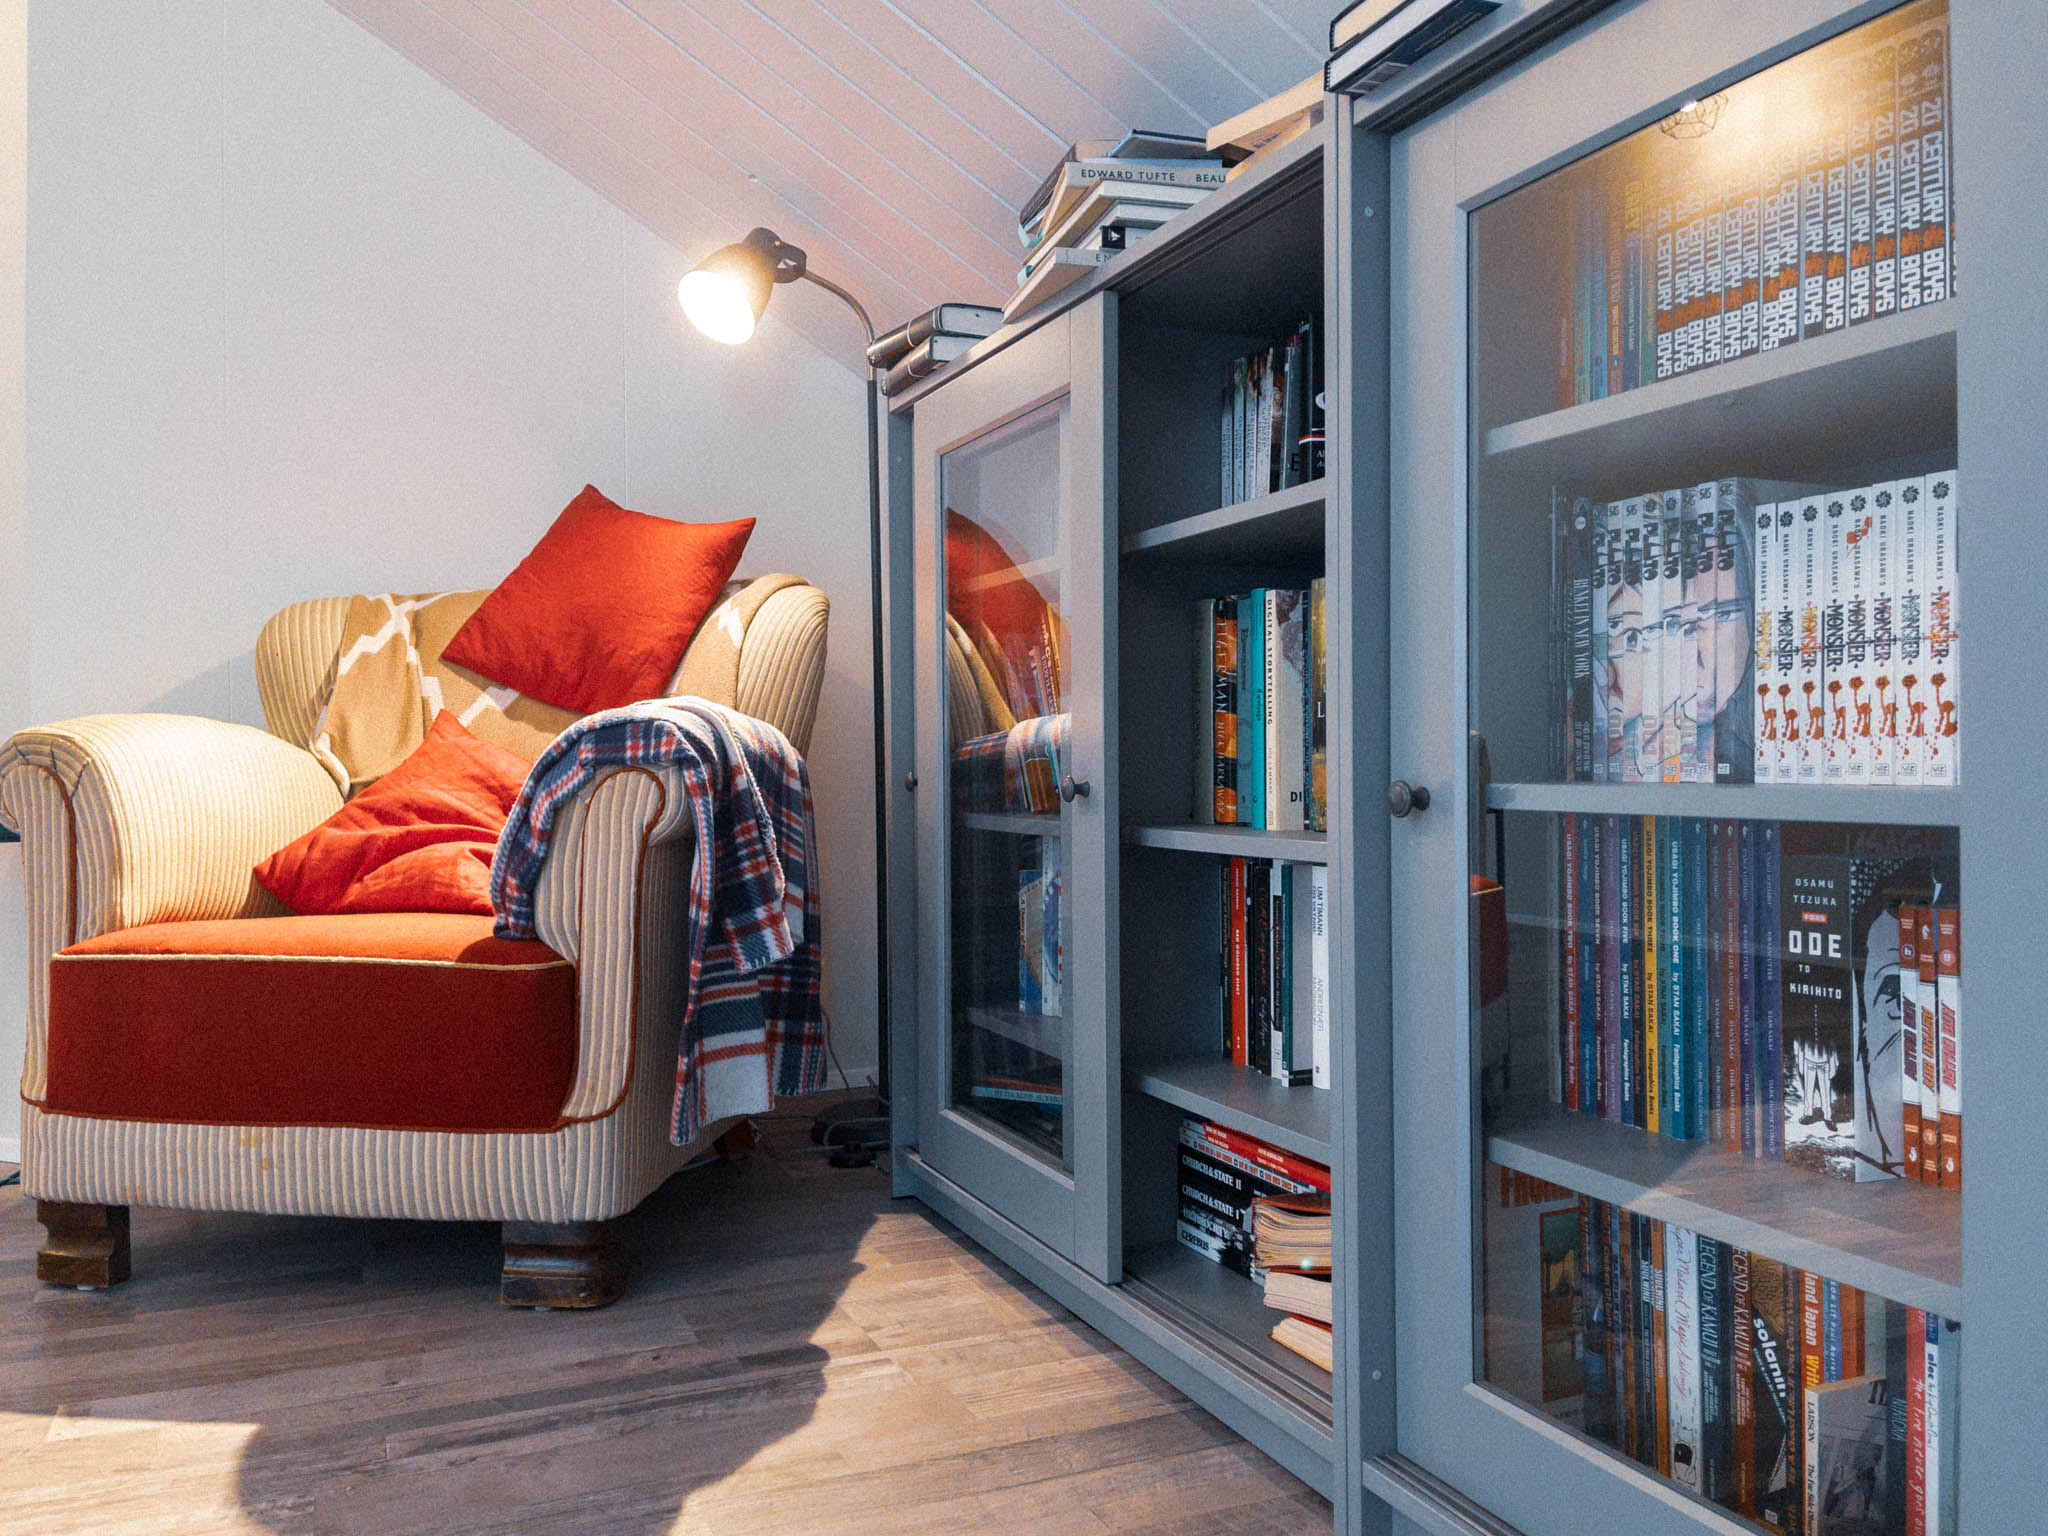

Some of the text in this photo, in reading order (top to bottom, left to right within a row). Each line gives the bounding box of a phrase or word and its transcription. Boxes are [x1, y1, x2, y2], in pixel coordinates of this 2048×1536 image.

[1081, 169, 1133, 180] EDWARD
[1138, 171, 1176, 182] TUFTE
[1850, 152, 1870, 243] CENTURY
[1875, 143, 1896, 235] CENTURY
[1900, 138, 1920, 231] CENTURY
[1921, 129, 1944, 223] CENTURY
[1742, 196, 1758, 351] CENTURY BOYS
[1763, 192, 1780, 351] CENTURY BOYS
[1779, 179, 1798, 339] CENTURY BOYS
[1805, 168, 1824, 326] CENTURY BOYS
[1825, 164, 1845, 330] CENTURY BOYS
[1706, 212, 1722, 364] CENTURY BOYS
[1724, 206, 1742, 359] CENTURY BOYS
[1850, 265, 1870, 320] BOYS
[1875, 257, 1896, 314] BOYS
[1900, 253, 1920, 311] BOYS
[1921, 246, 1944, 304] BOYS
[1657, 233, 1672, 378] CENTURY BOYS
[1674, 325, 1688, 373] BOYS
[1688, 318, 1704, 367] BOYS
[1783, 533, 1791, 556] NAOKI
[1936, 505, 1945, 530] NAOKI
[1778, 609, 1794, 672] MONSTER
[1826, 603, 1844, 668] MONSTER
[1847, 600, 1866, 664] MONSTER
[1873, 597, 1892, 662] MONSTER
[1317, 886, 1323, 900] UM
[1793, 894, 1837, 906] TEZUKA
[1795, 878, 1835, 889] OSAMU
[1788, 929, 1842, 959] ODE
[1799, 964, 1811, 974] TO
[1672, 972, 1679, 982] by
[1789, 982, 1842, 1000] KIRIHITO
[1235, 1177, 1242, 1191] II
[1654, 1269, 1664, 1312] SOULWIND
[1700, 1237, 1717, 1291] LEGEND
[1701, 1303, 1718, 1349] KAMUI
[1734, 1304, 1750, 1351] KAMUI
[1804, 1307, 1817, 1346] Japan
[1928, 1353, 1937, 1380] alec
[1807, 1401, 1816, 1508] LARSON The Far Side
[1912, 1435, 1924, 1471] never
